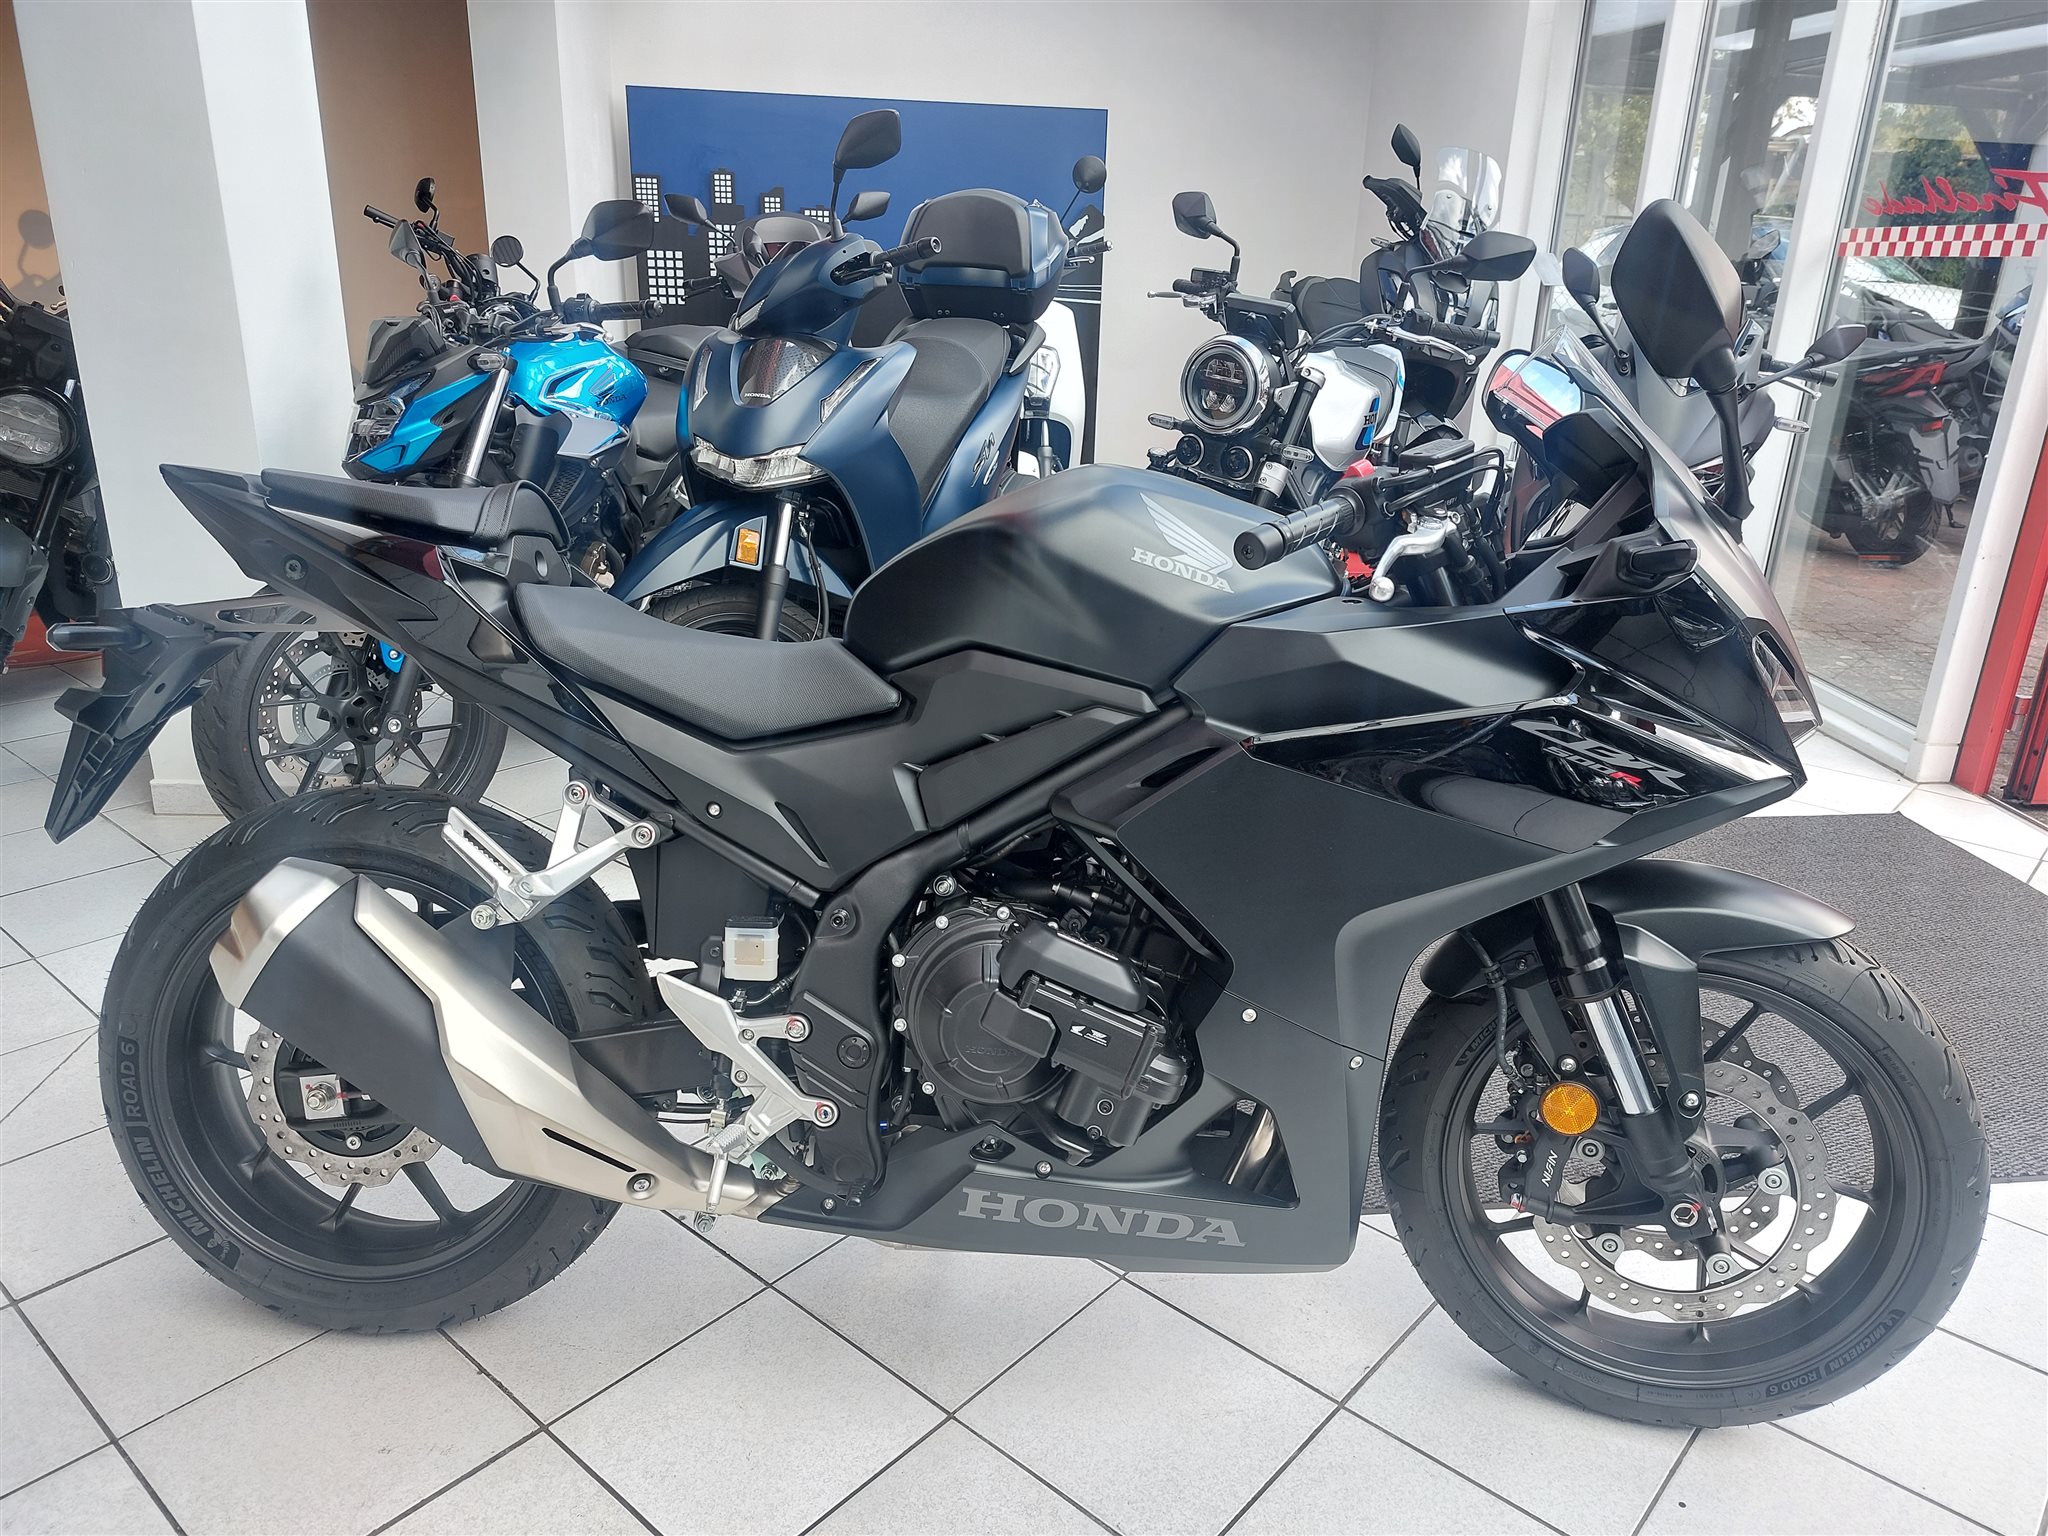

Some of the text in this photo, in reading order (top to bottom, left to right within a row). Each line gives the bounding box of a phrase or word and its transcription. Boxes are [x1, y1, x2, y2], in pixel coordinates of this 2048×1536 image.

[1130, 546, 1235, 594] HONDA
[1511, 719, 1690, 794] CBR
[1543, 746, 1643, 789] 500R
[120, 1041, 211, 1238] MICHELIN ROAD 6
[958, 1187, 1247, 1247] HONDA
[1769, 1325, 1890, 1394] MICHELIN ROAD 6
